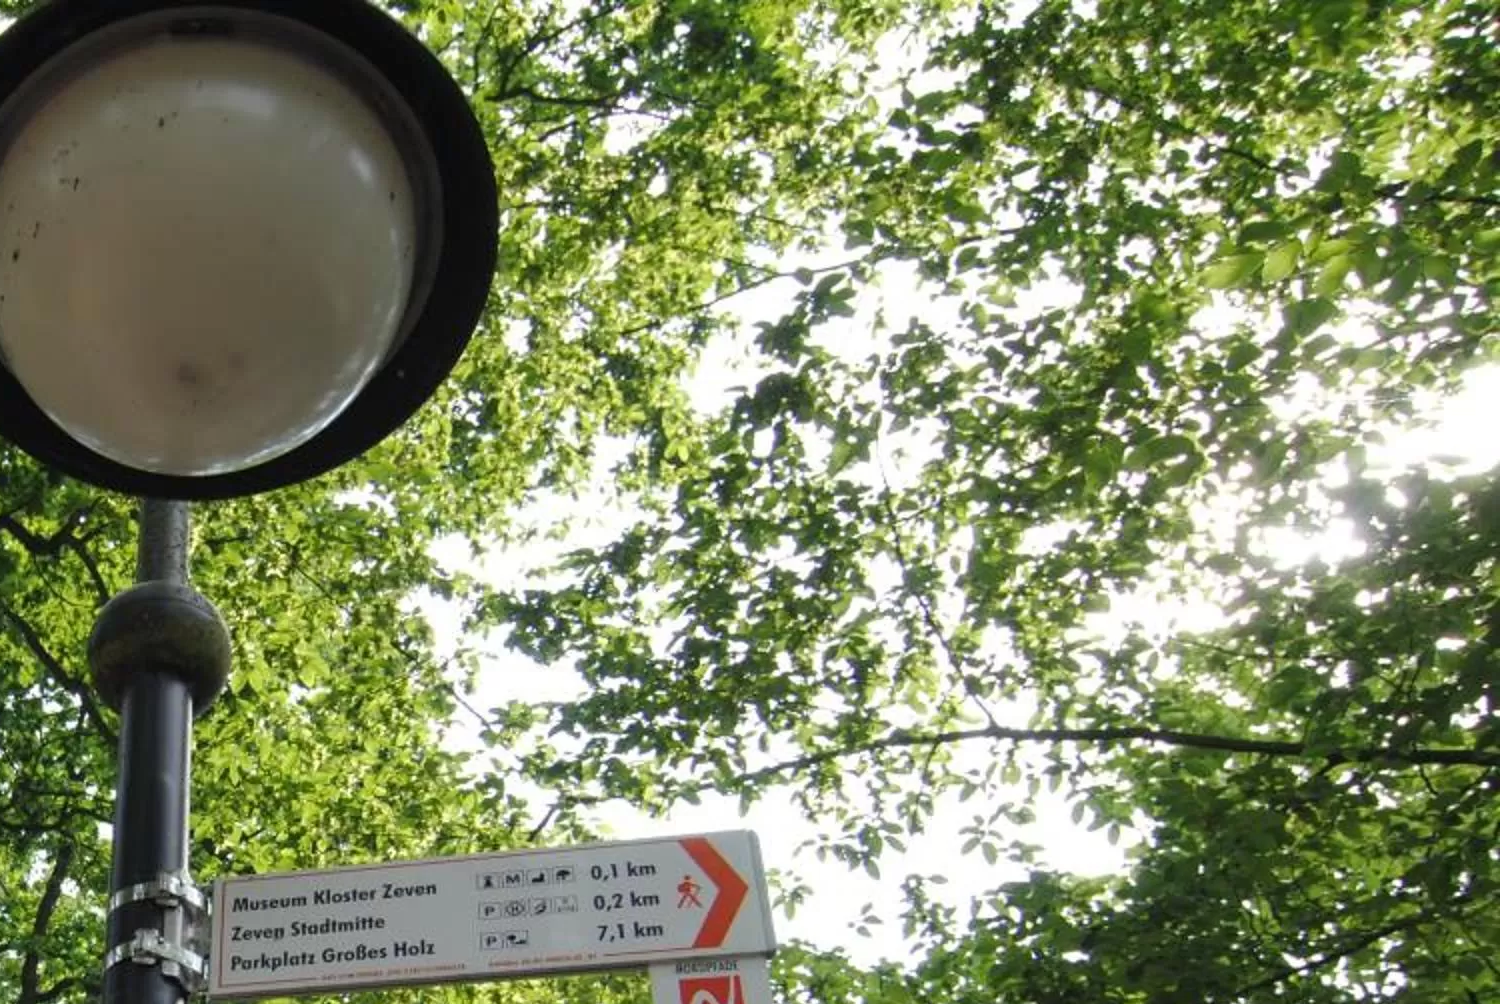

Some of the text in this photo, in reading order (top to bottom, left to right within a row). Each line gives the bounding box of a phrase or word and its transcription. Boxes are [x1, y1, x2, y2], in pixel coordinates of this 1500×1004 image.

[590, 861, 656, 882] 0,1 km
[232, 882, 437, 912] Museum Kloster Zeven
[594, 892, 660, 913] 0,2 km
[231, 916, 385, 942] Zeven Stadtmitte
[597, 922, 664, 943] 7,1 km
[230, 950, 316, 972] Parkplatz
[322, 944, 388, 964] Großes
[394, 939, 436, 957] Holz
